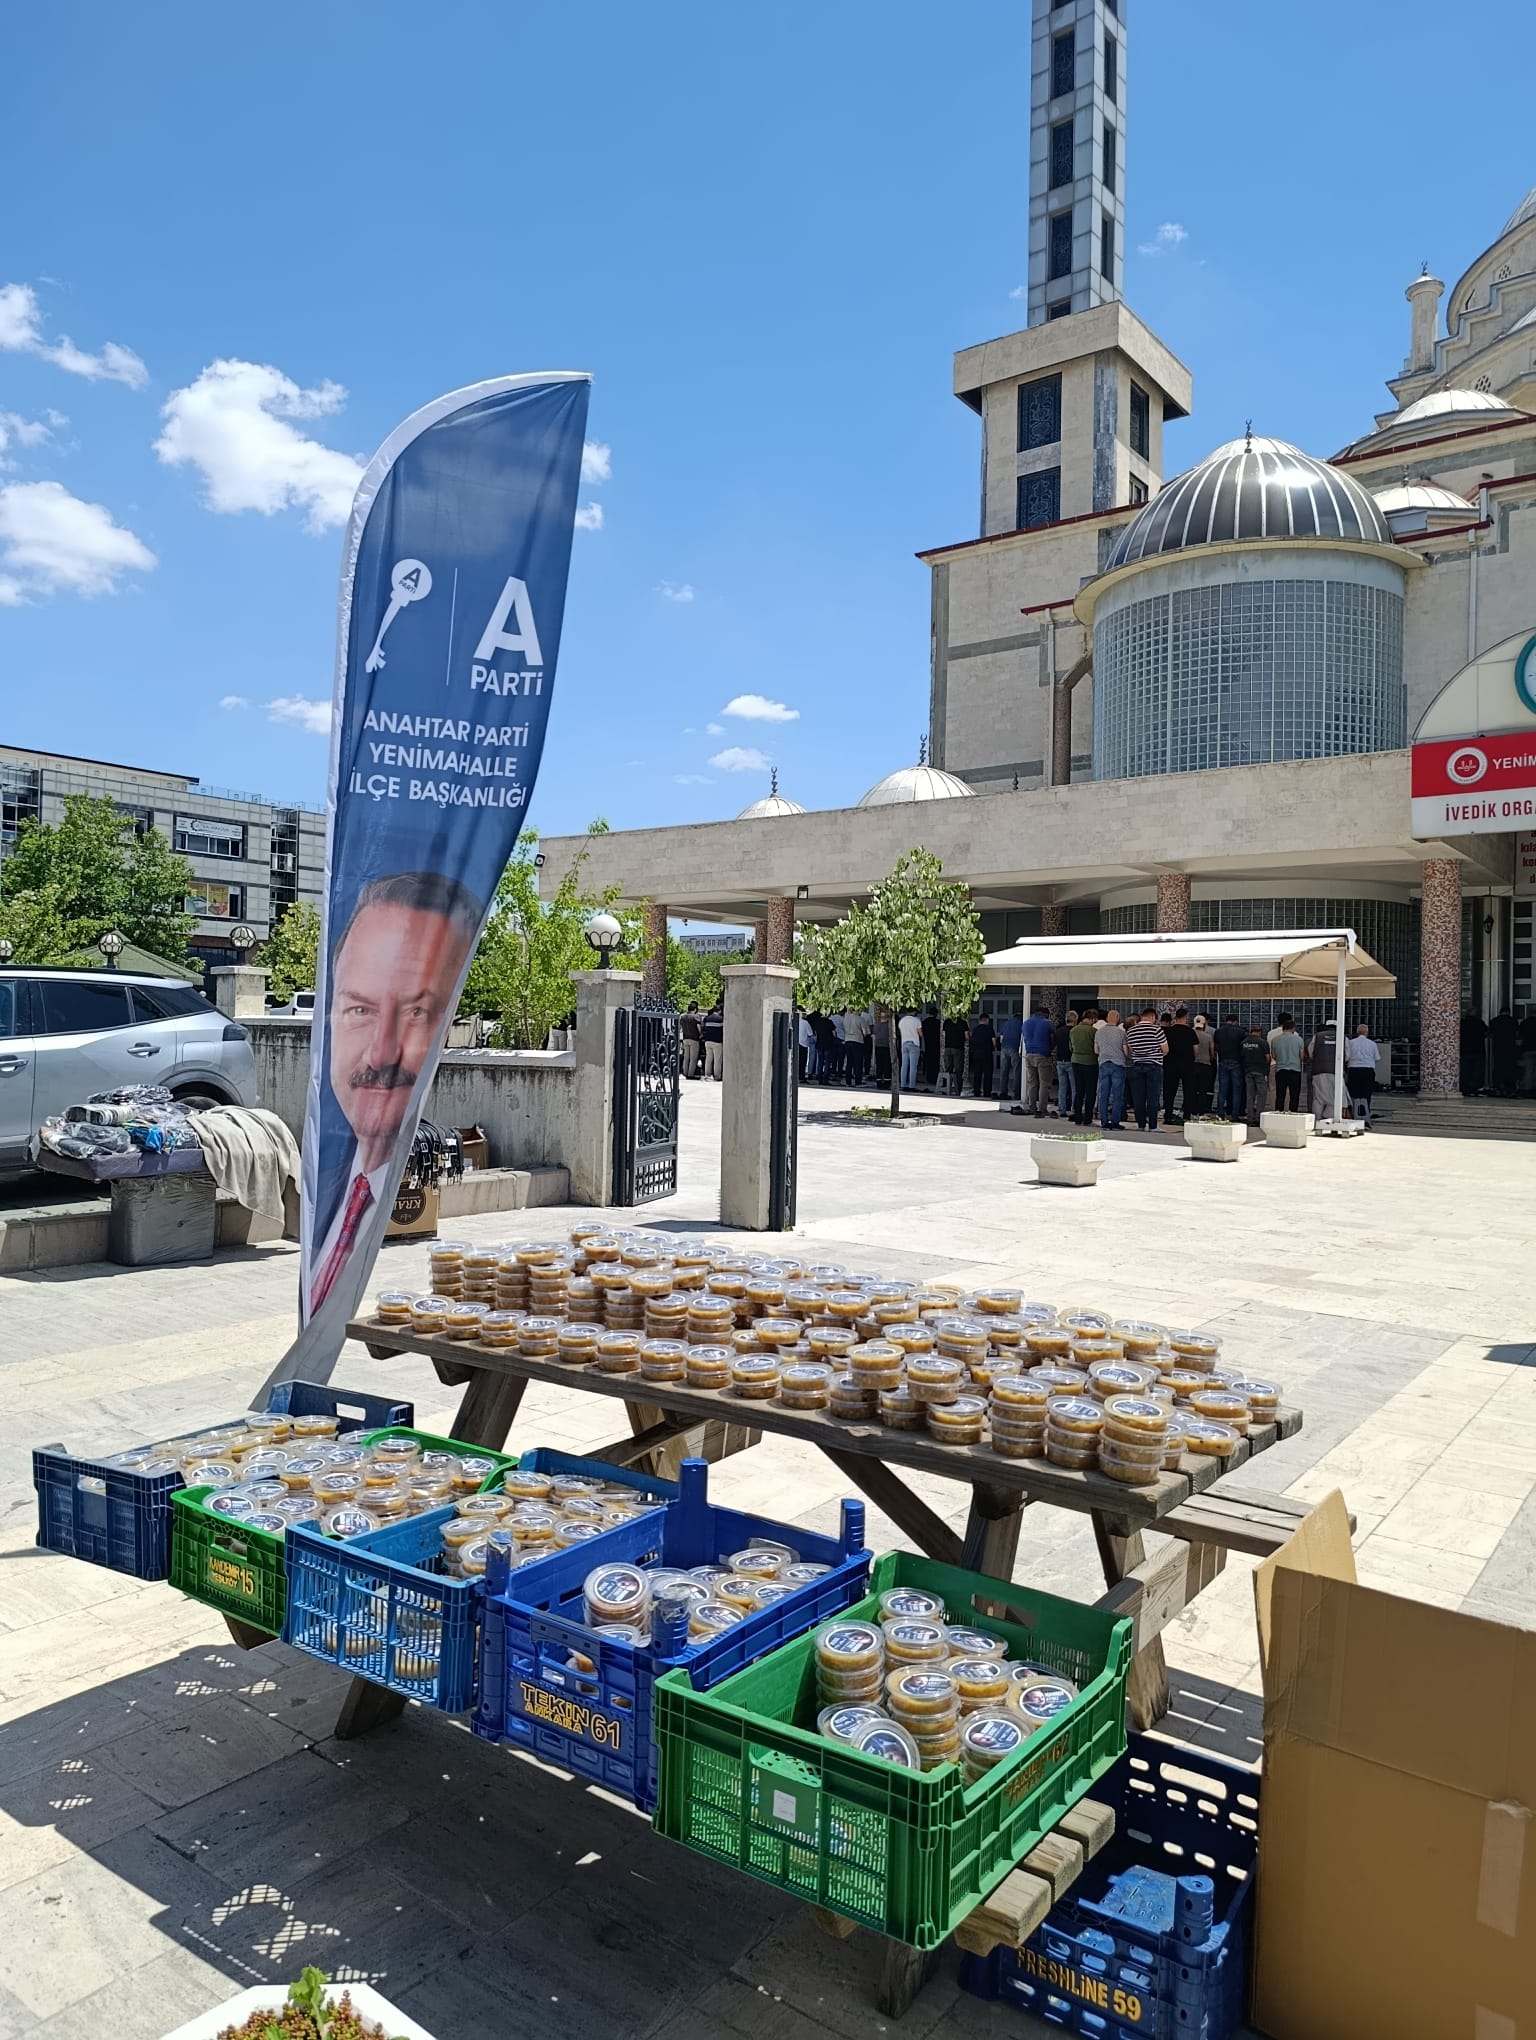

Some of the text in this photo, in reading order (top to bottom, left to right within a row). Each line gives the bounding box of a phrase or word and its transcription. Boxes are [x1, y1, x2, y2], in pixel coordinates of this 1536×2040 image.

[402, 567, 422, 589] A
[472, 575, 544, 666] A
[363, 709, 529, 748] ANAHTAR PARTİ
[369, 742, 518, 778] YENİMAHALLE
[349, 766, 528, 809] İLÇE BAŞKANLIĞI
[1445, 800, 1536, 822] İVEDİK ORG
[240, 1568, 255, 1595] 15
[590, 1713, 620, 1750] 61
[1112, 1988, 1142, 2022] 59
